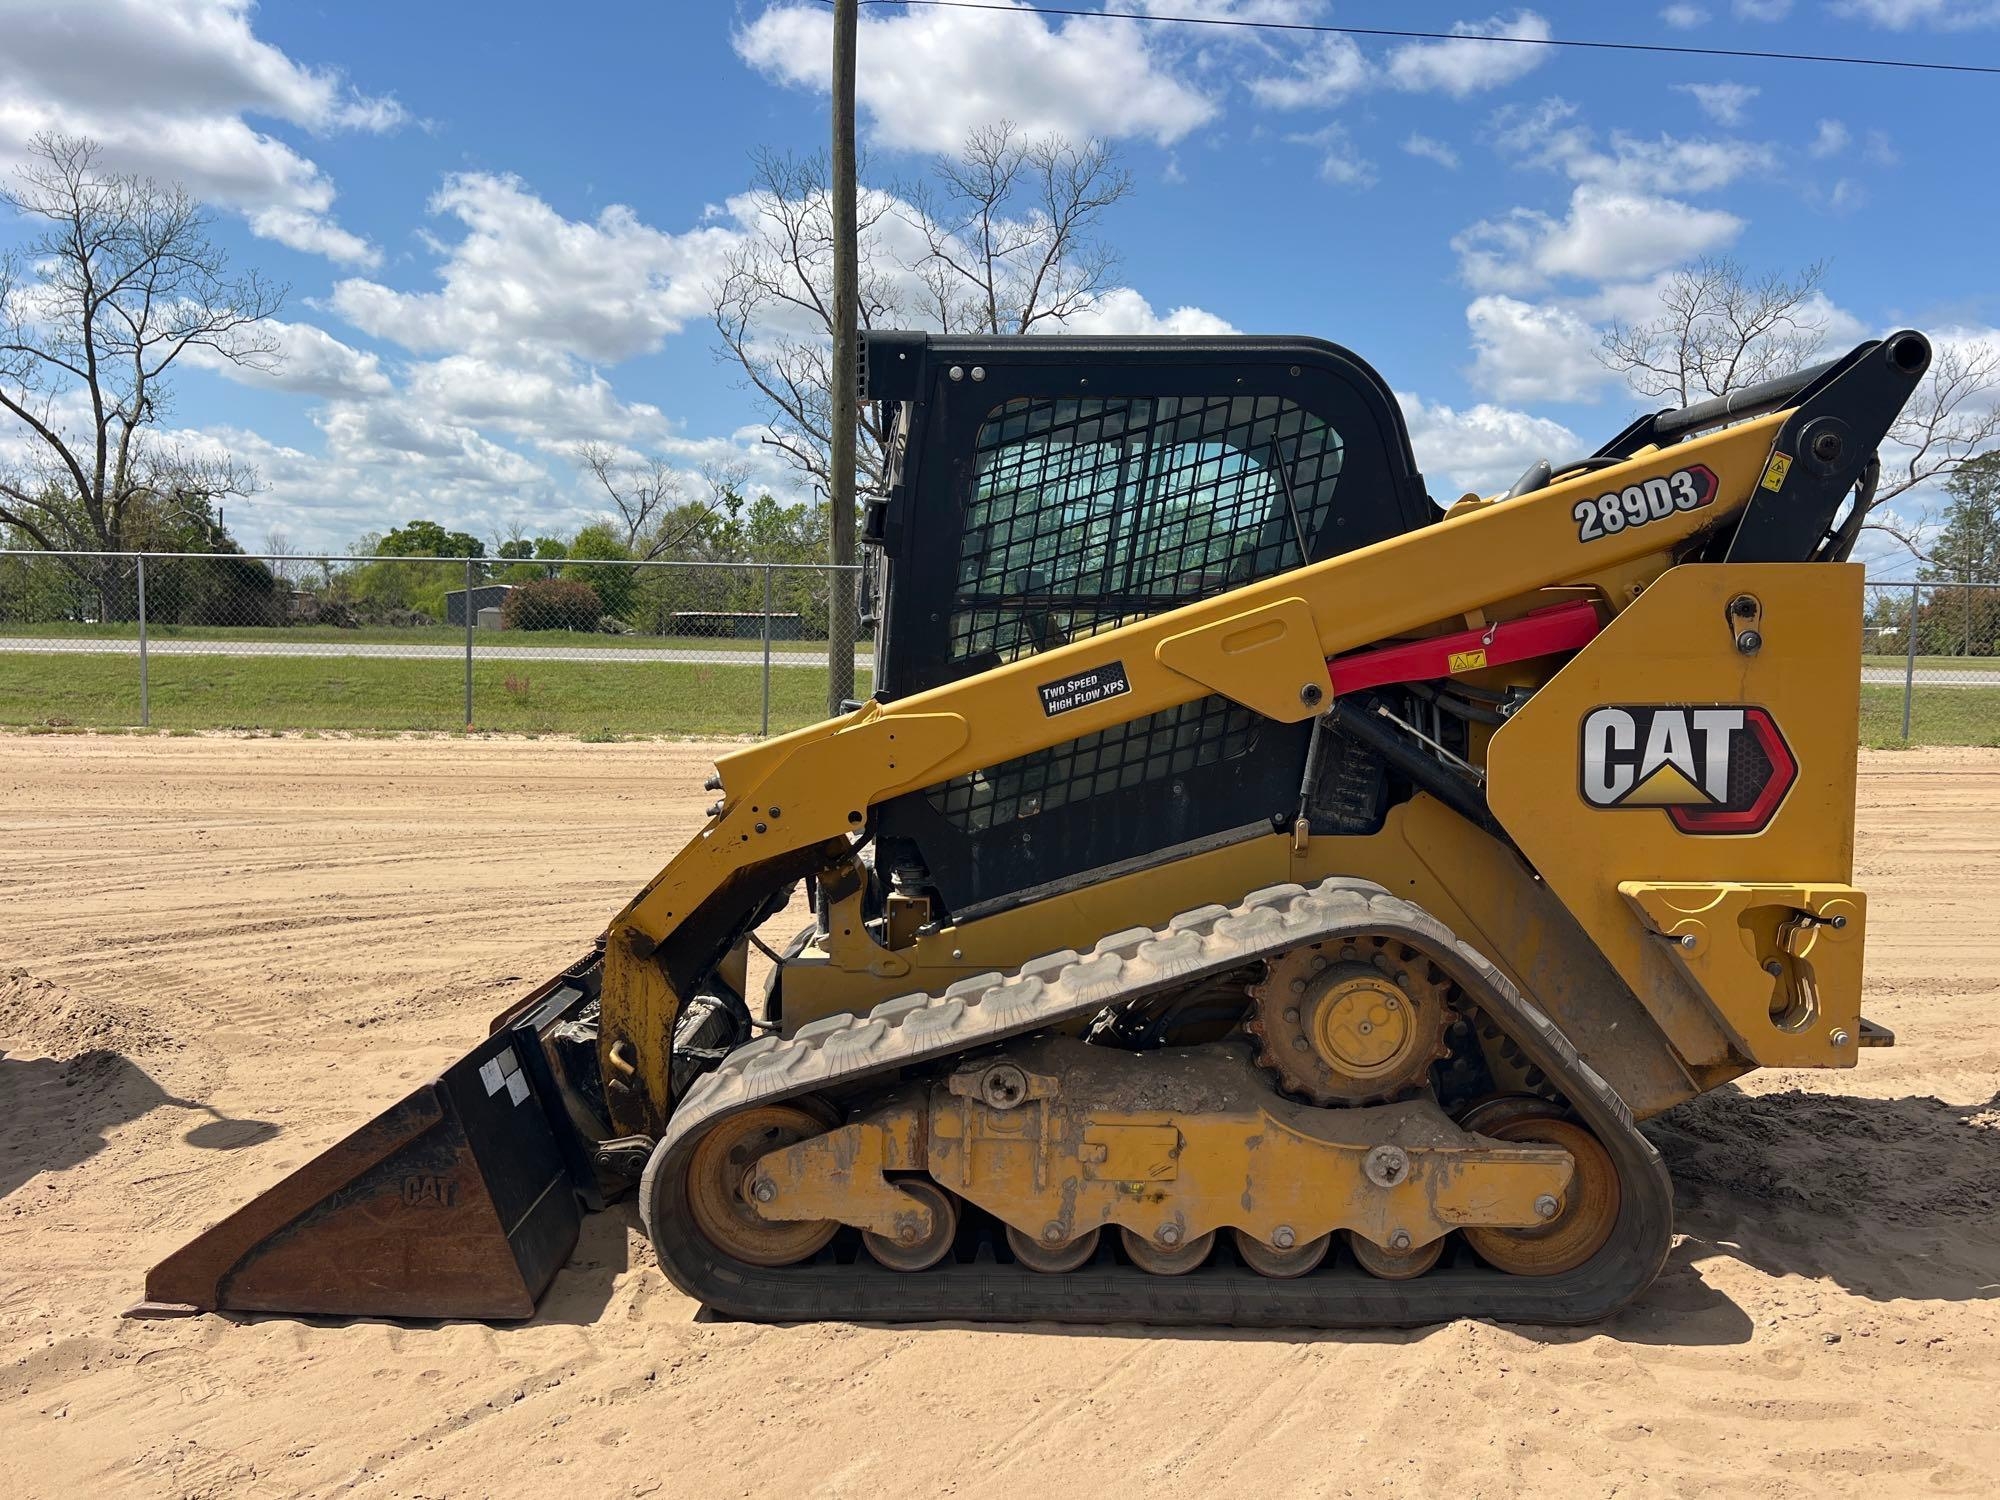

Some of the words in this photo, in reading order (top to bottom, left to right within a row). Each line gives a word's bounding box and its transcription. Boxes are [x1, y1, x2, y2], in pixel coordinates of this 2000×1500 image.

[1574, 471, 1698, 541] 289D3
[1103, 679, 1124, 696] XPS
[1584, 708, 1744, 804] CAT
[403, 1176, 457, 1207] CAT
